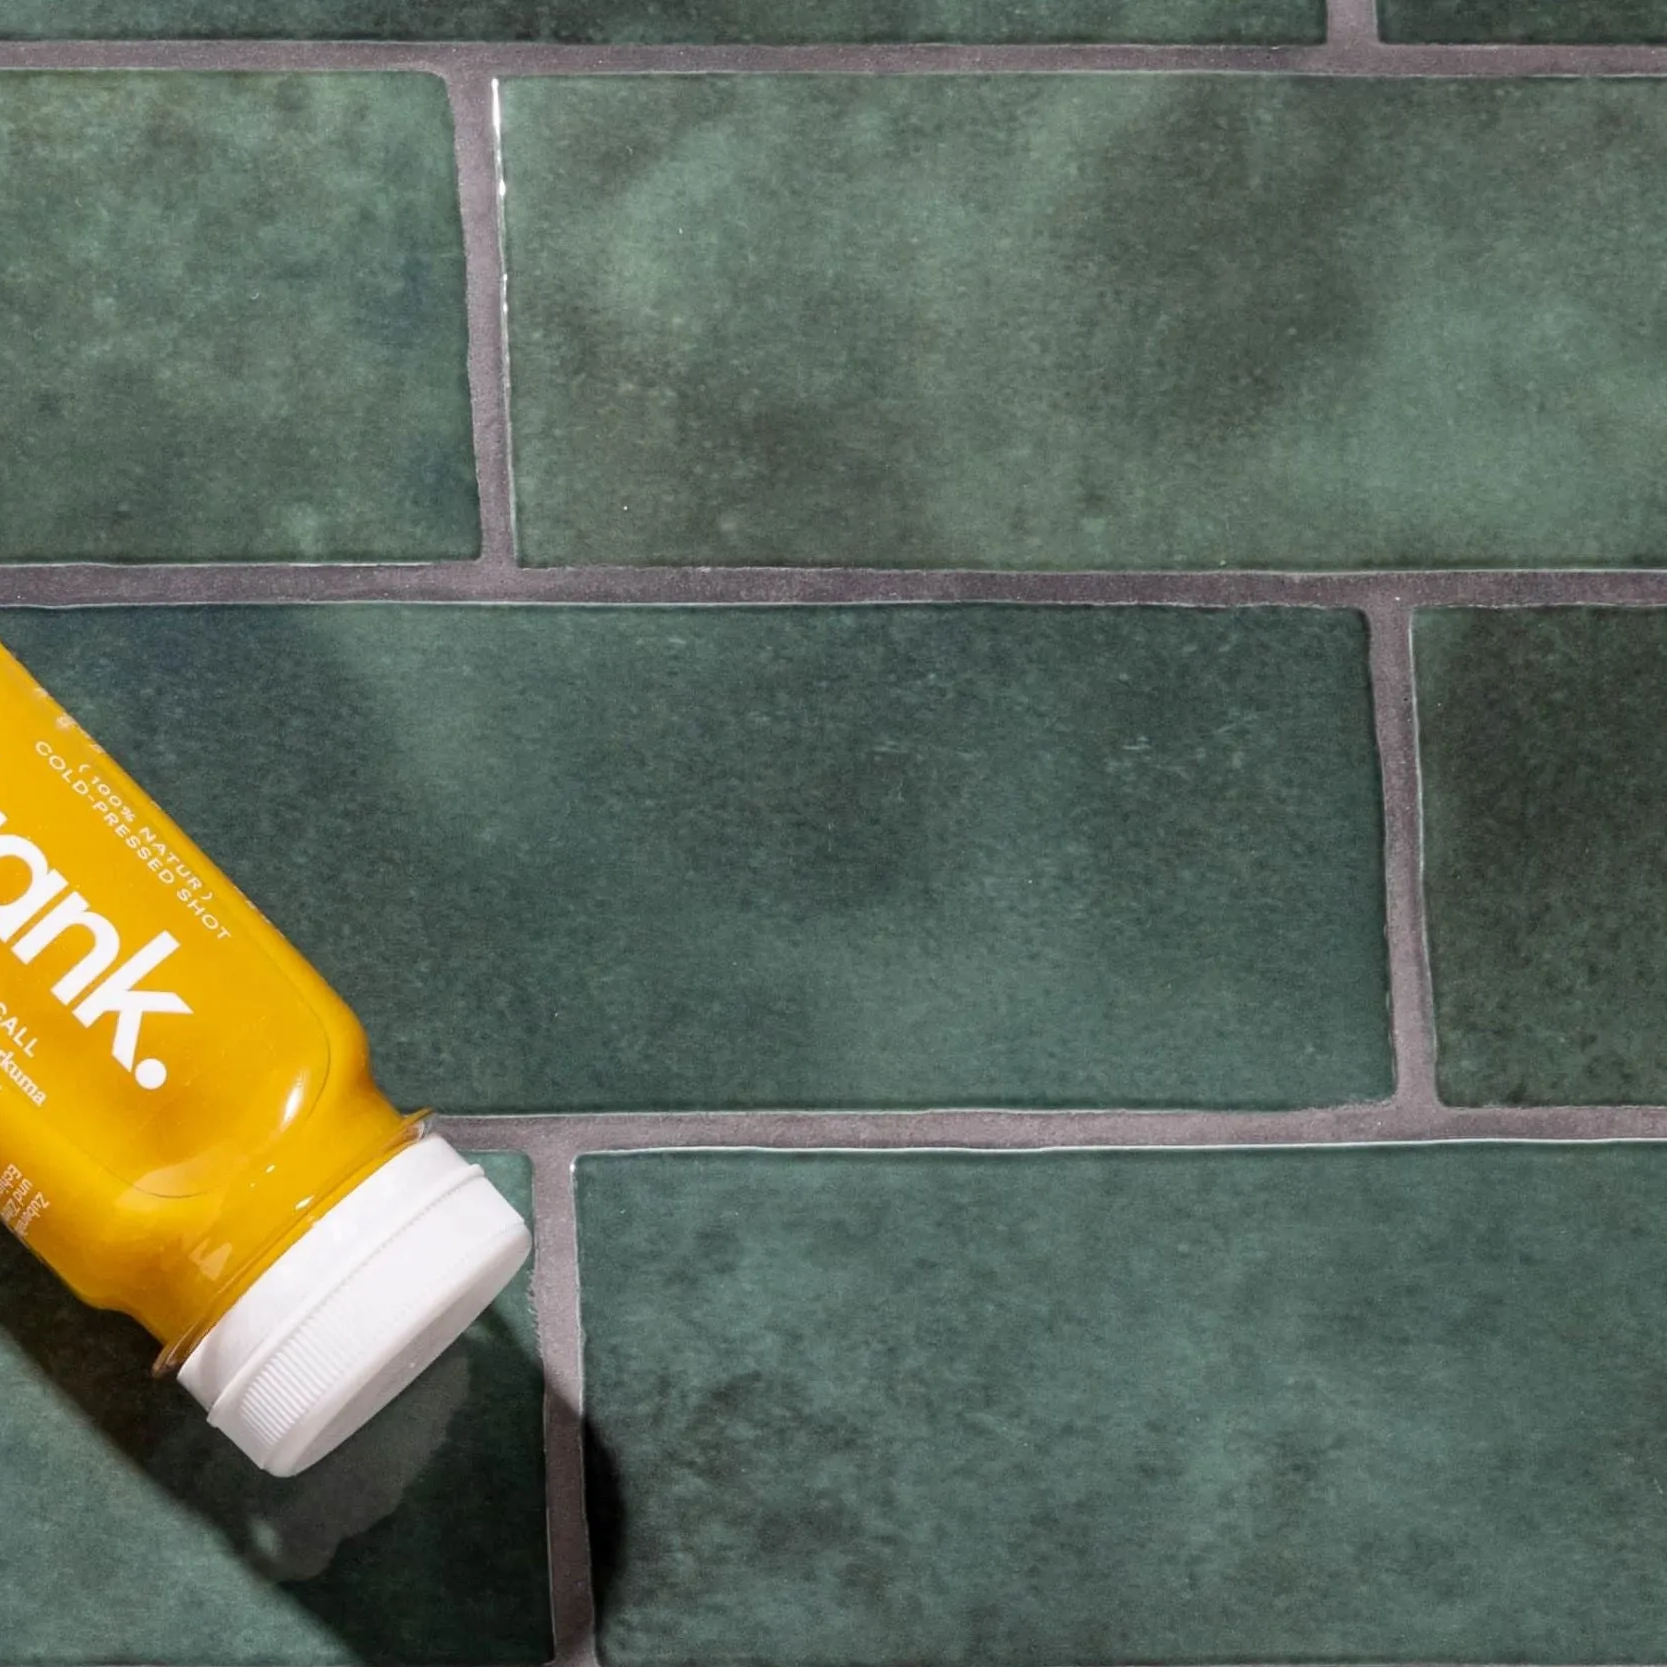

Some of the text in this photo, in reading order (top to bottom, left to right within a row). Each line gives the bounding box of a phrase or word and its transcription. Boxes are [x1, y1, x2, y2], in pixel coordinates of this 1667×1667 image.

[34, 740, 174, 884] COLD-PRESSED
[176, 888, 230, 938] SHOT
[139, 826, 201, 889] NATUR
